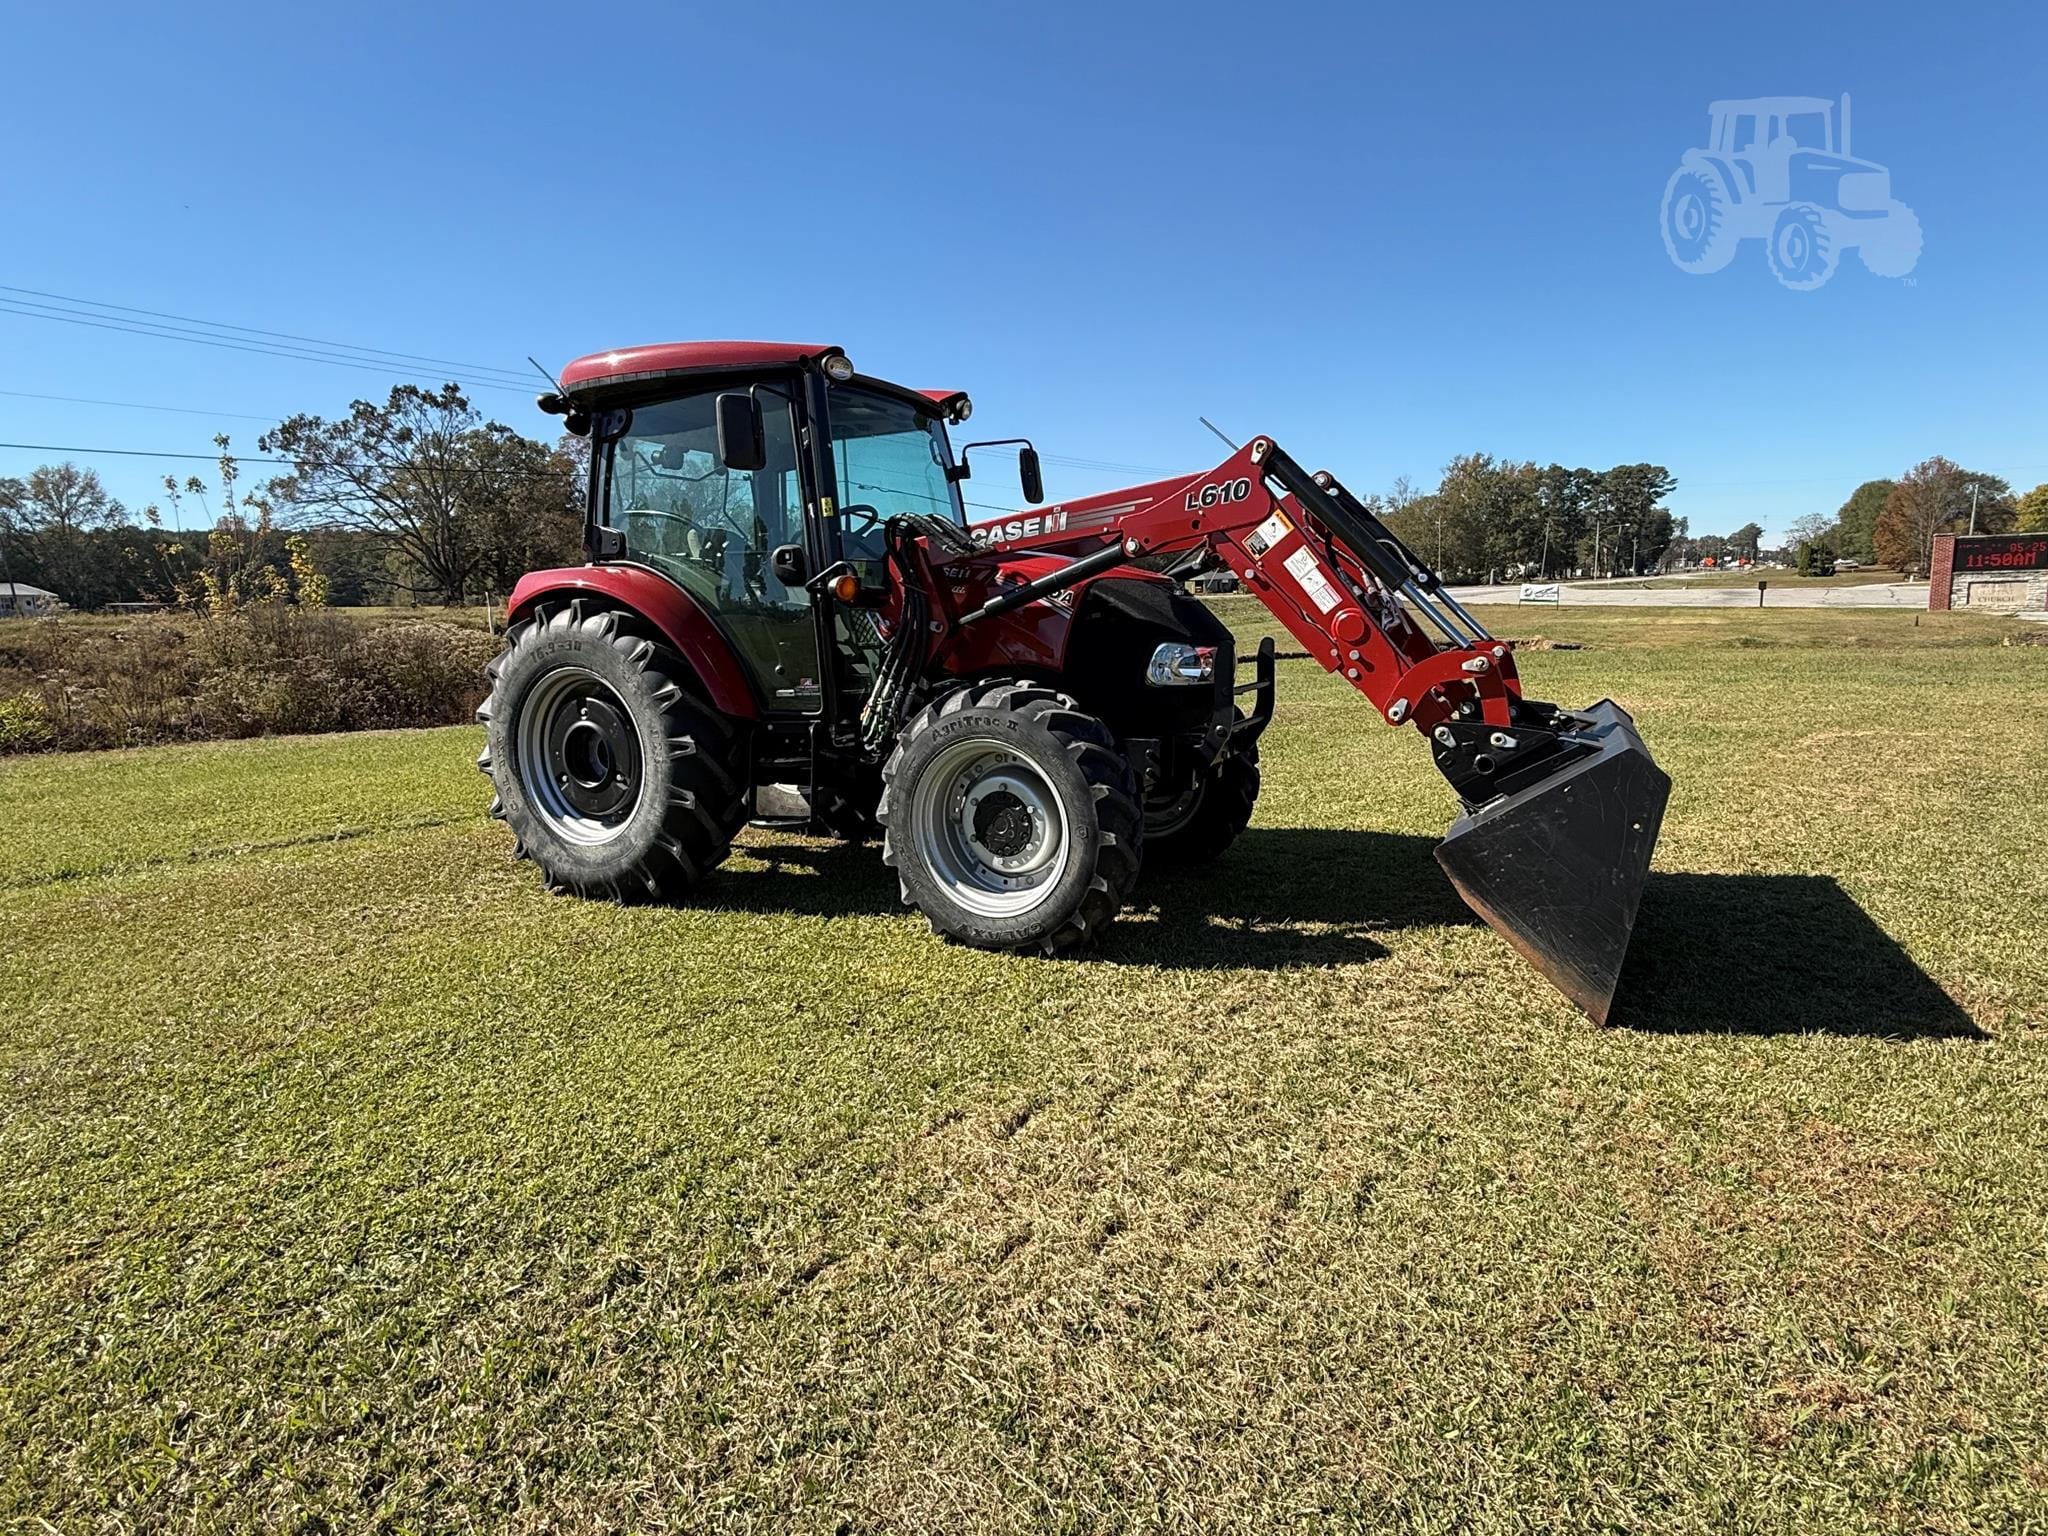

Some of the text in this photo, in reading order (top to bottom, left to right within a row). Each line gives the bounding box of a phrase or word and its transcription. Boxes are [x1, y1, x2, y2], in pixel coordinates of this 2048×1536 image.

[1184, 477, 1252, 511] L610
[970, 517, 1041, 548] CASE
[1966, 551, 2037, 568] 11:50AM
[931, 715, 1000, 742] AgriTrac
[956, 922, 1045, 941] GALAXY
